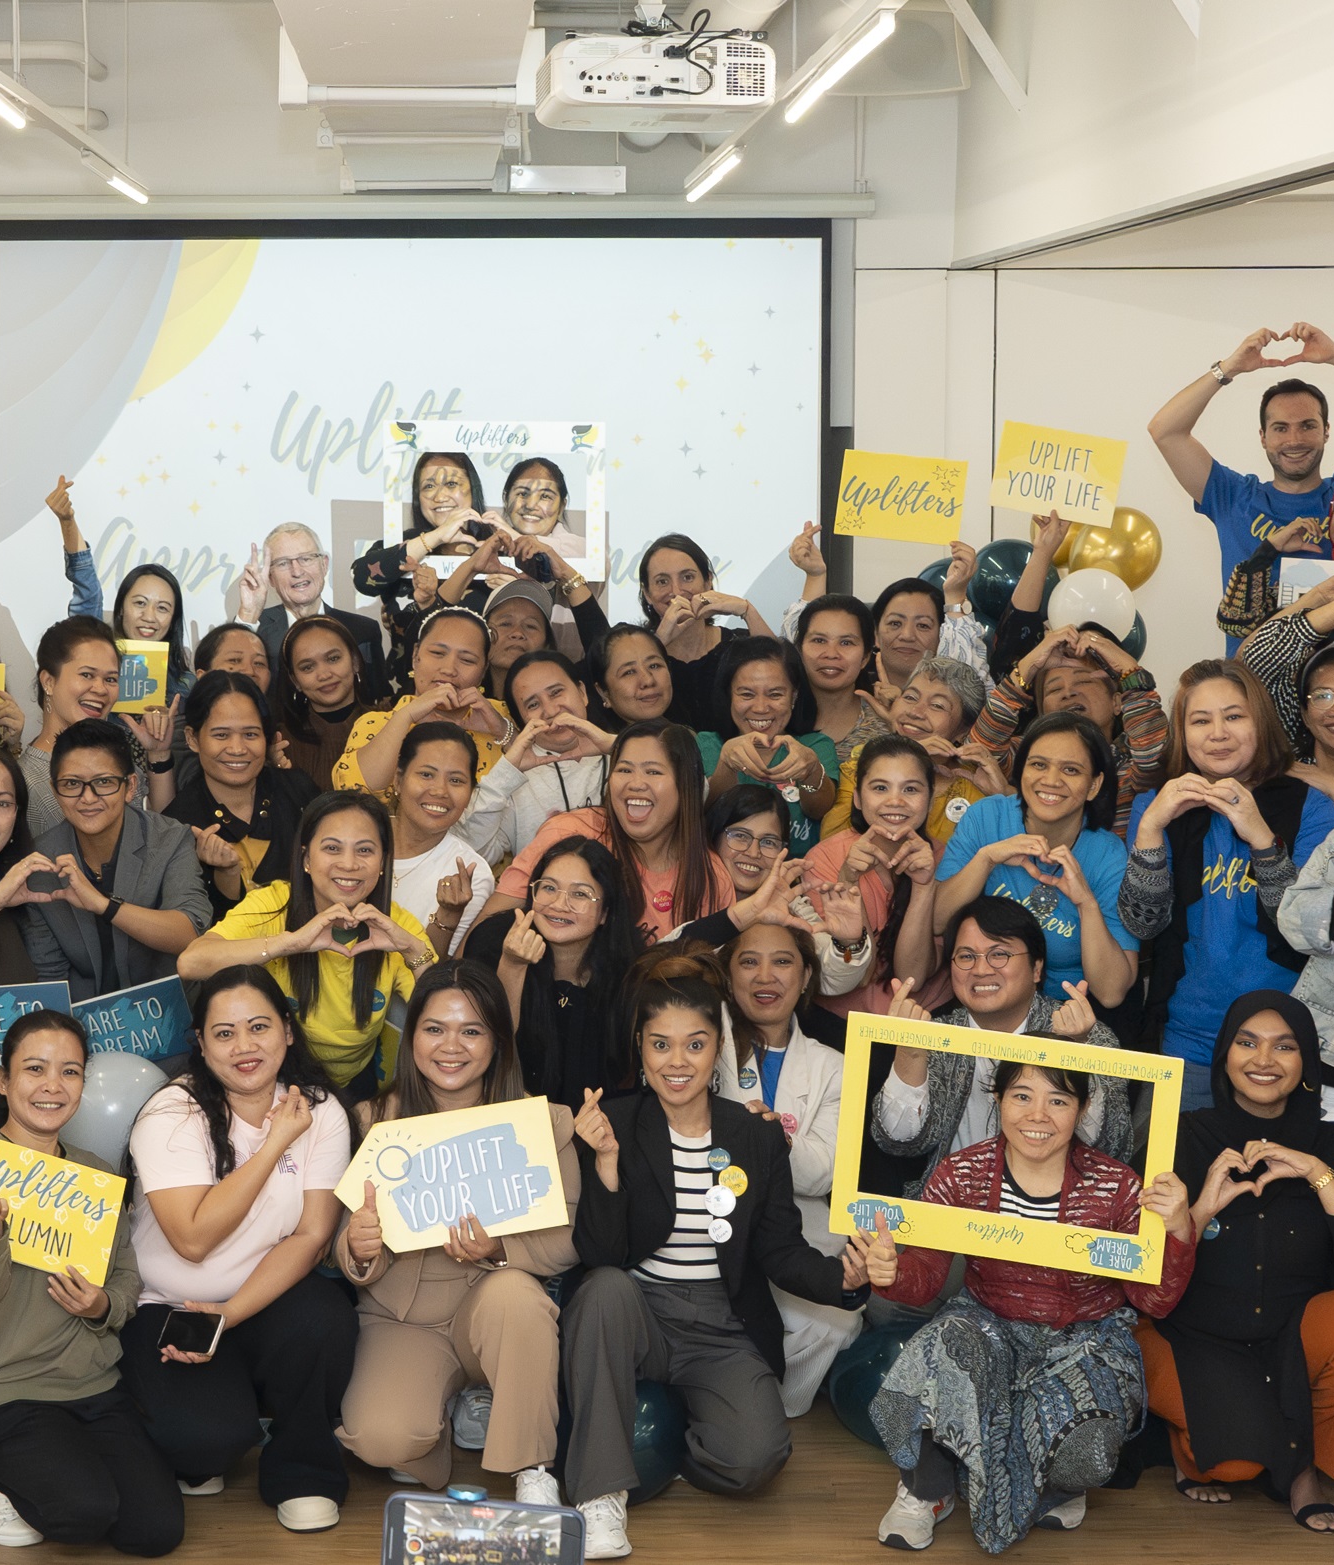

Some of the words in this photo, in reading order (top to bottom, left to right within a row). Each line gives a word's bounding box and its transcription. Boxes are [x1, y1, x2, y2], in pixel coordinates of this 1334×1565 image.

[455, 422, 531, 447] Uplifters
[1030, 440, 1093, 474] UPLIFT
[841, 475, 962, 518] Uplifters
[1008, 471, 1055, 502] YOUR
[1065, 478, 1103, 511] LIFE
[125, 678, 150, 698] LIFE
[89, 1007, 127, 1037] ARE
[134, 998, 163, 1022] TO
[859, 1025, 951, 1048] #STRONGERTOGETHER
[971, 1041, 1047, 1062] #COMMUNITYLED
[1059, 1054, 1173, 1081] #EMPOWEREDTOEMPOWER
[419, 1135, 505, 1186] UPLIFT
[401, 1180, 477, 1232] YOUR
[490, 1171, 542, 1215] LIFE
[852, 1202, 870, 1215] LIFE
[7, 1220, 73, 1258] LUMNI
[966, 1221, 1025, 1245] Uplifters
[1095, 1238, 1129, 1255] DREAM
[1090, 1252, 1104, 1265] TO
[1109, 1256, 1133, 1269] DARE
